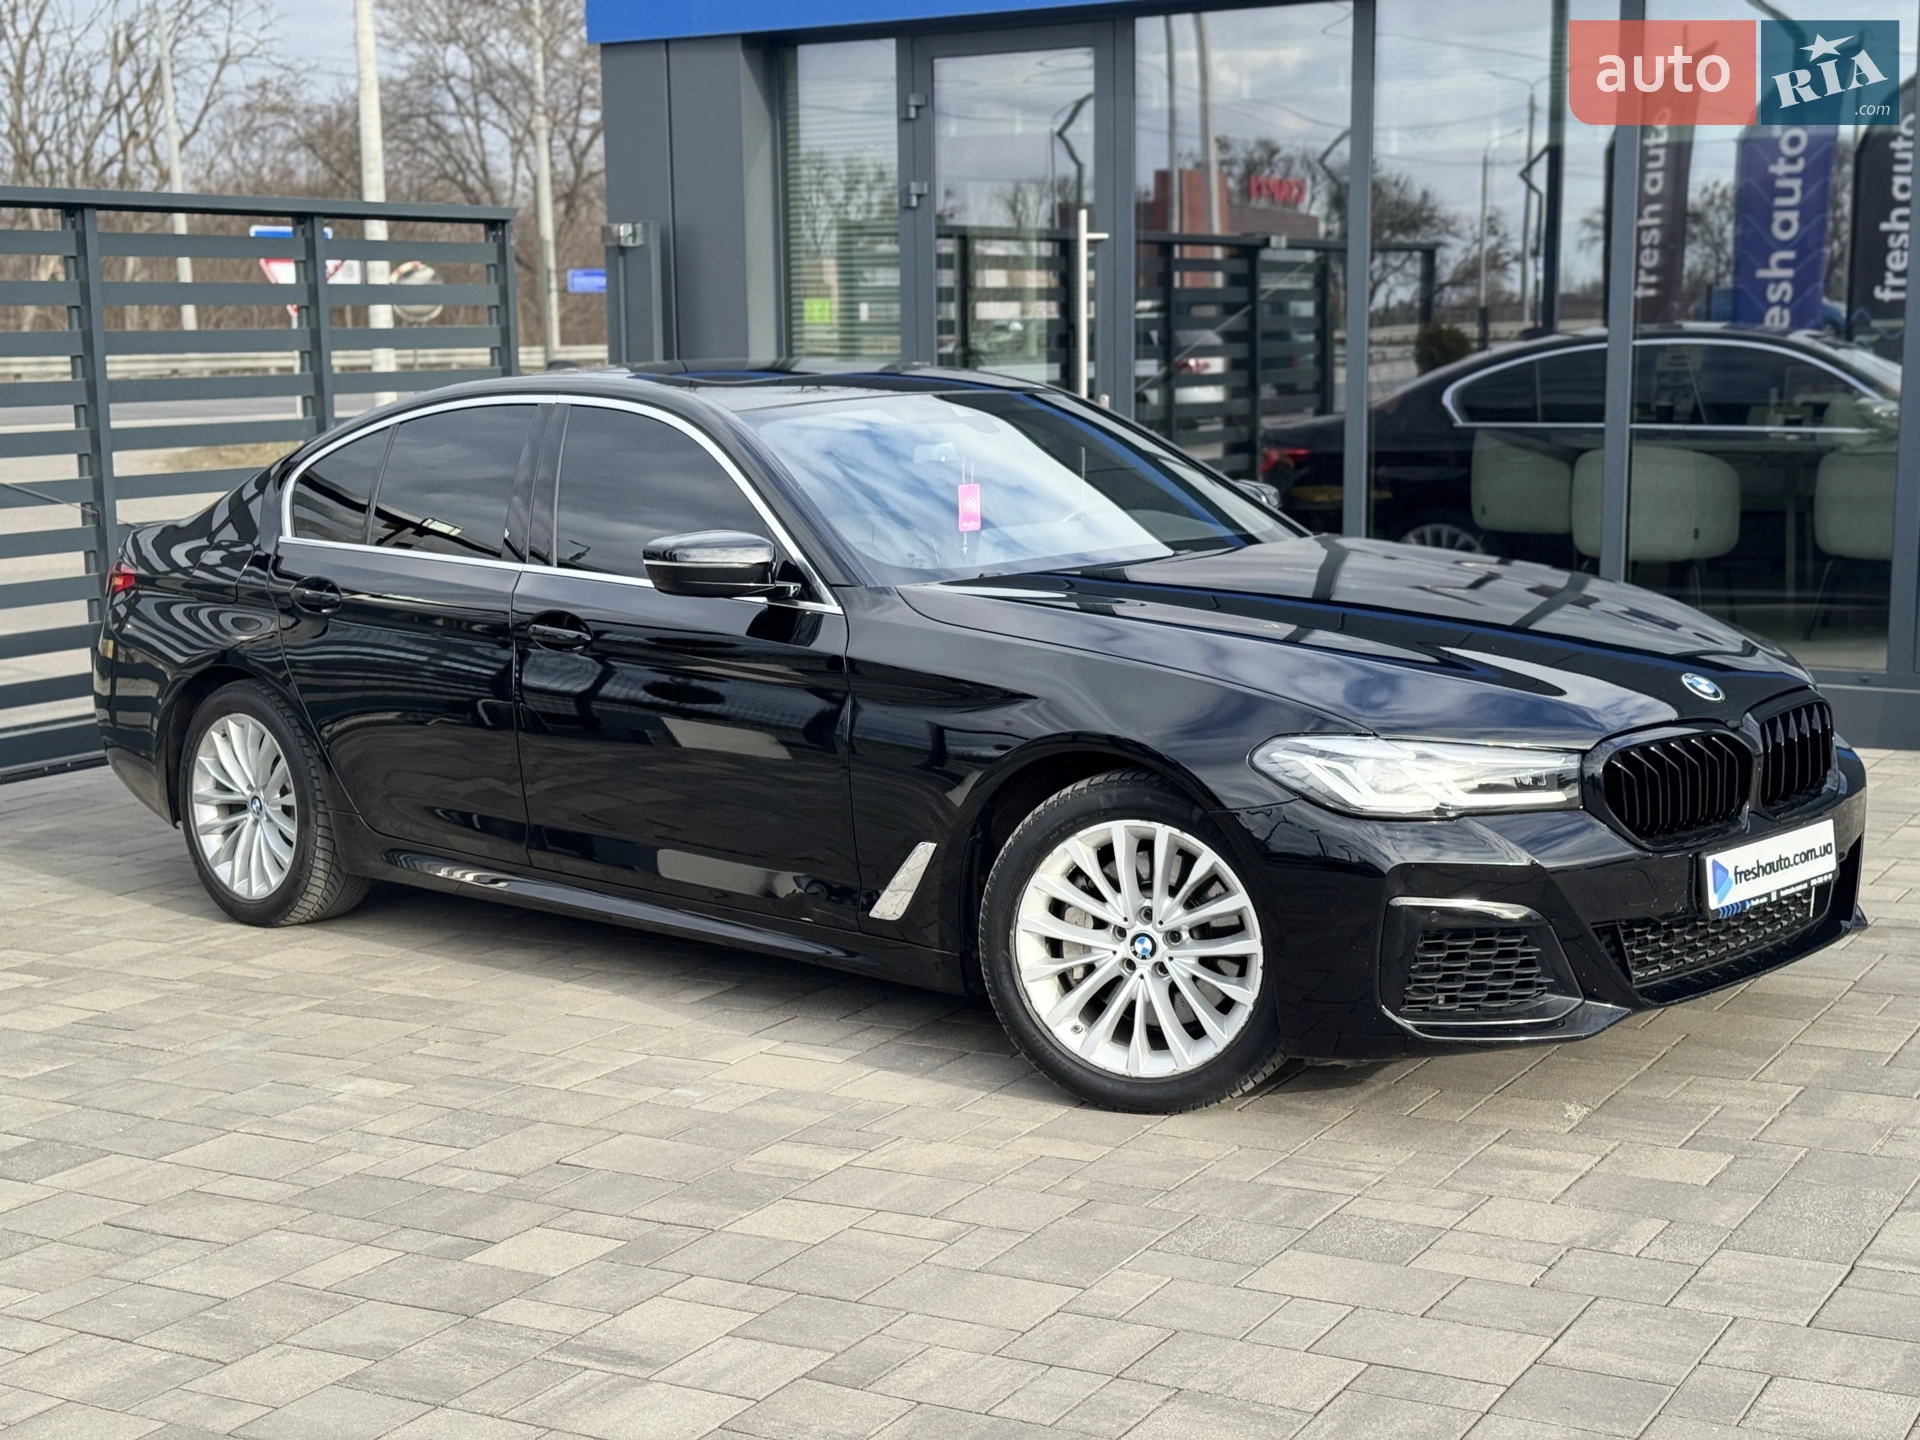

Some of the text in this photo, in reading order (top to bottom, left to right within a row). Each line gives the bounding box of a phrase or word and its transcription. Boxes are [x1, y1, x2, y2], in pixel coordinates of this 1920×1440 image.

[1634, 203, 1663, 299] fresh
[1755, 127, 1809, 329] esh auto
[1873, 206, 1911, 302] fresh
[1733, 842, 1833, 885] freshauto.com.ua
